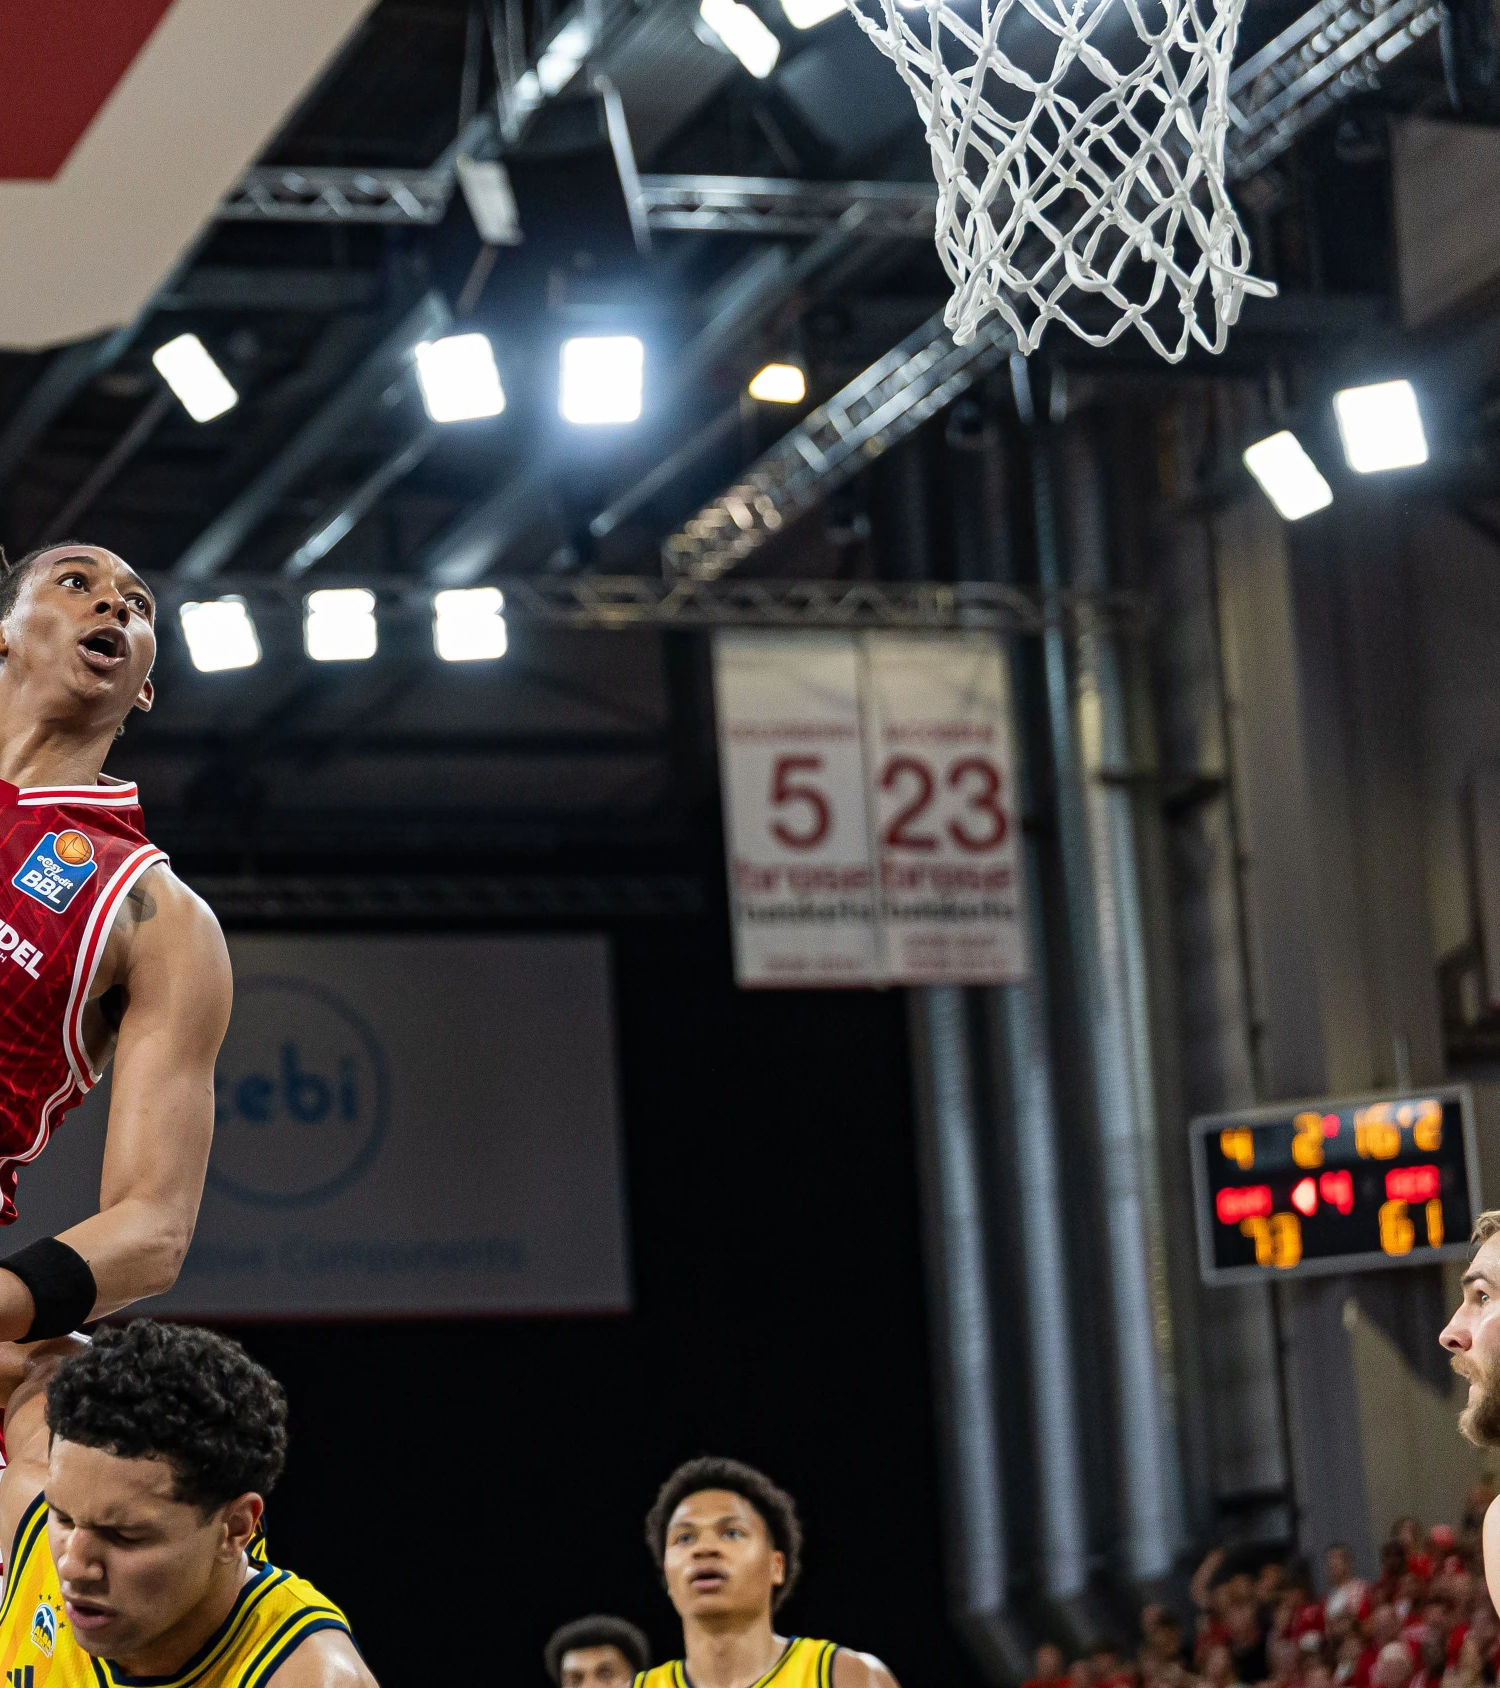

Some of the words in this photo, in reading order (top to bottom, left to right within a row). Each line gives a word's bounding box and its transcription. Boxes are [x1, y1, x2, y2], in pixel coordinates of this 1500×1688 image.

[768, 752, 832, 852] 5
[879, 753, 1009, 853] 23
[20, 869, 63, 904] BBL
